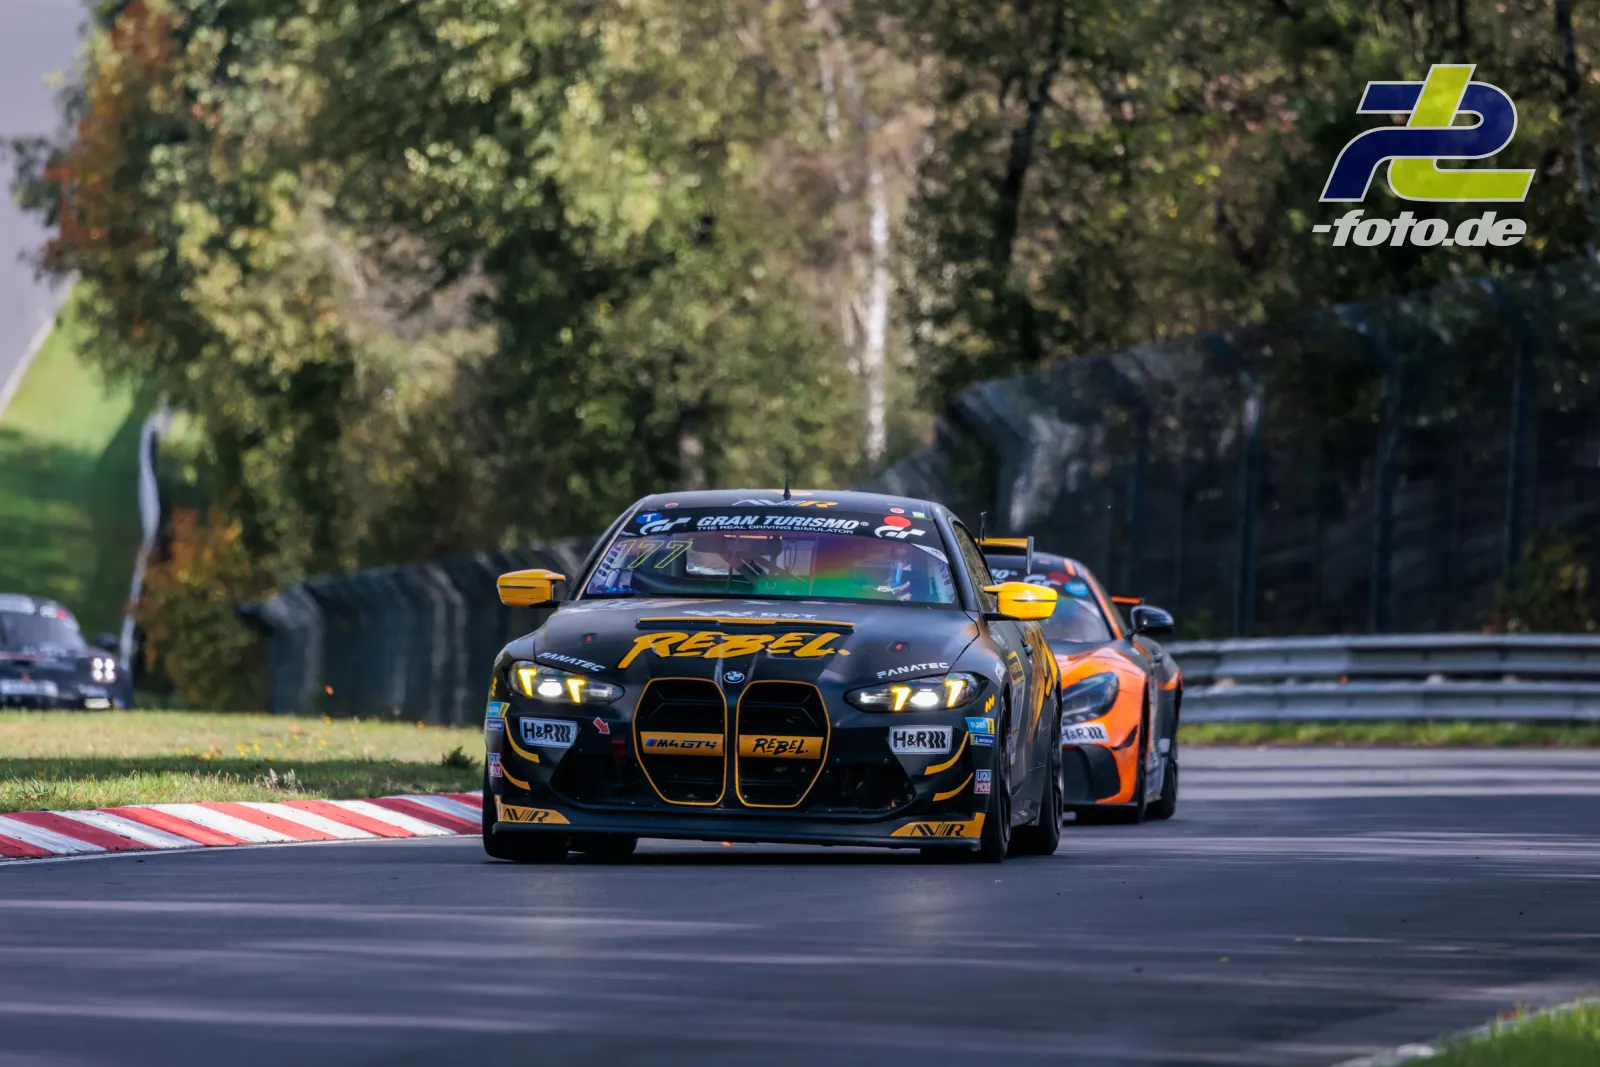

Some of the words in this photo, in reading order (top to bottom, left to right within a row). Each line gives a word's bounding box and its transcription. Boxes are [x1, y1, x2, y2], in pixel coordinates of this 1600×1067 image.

[697, 515, 760, 527] GRAN
[794, 526, 854, 535] SIMULATOR
[610, 539, 694, 569] 177
[537, 652, 606, 673] FANATEC
[877, 662, 949, 679] FANATEC
